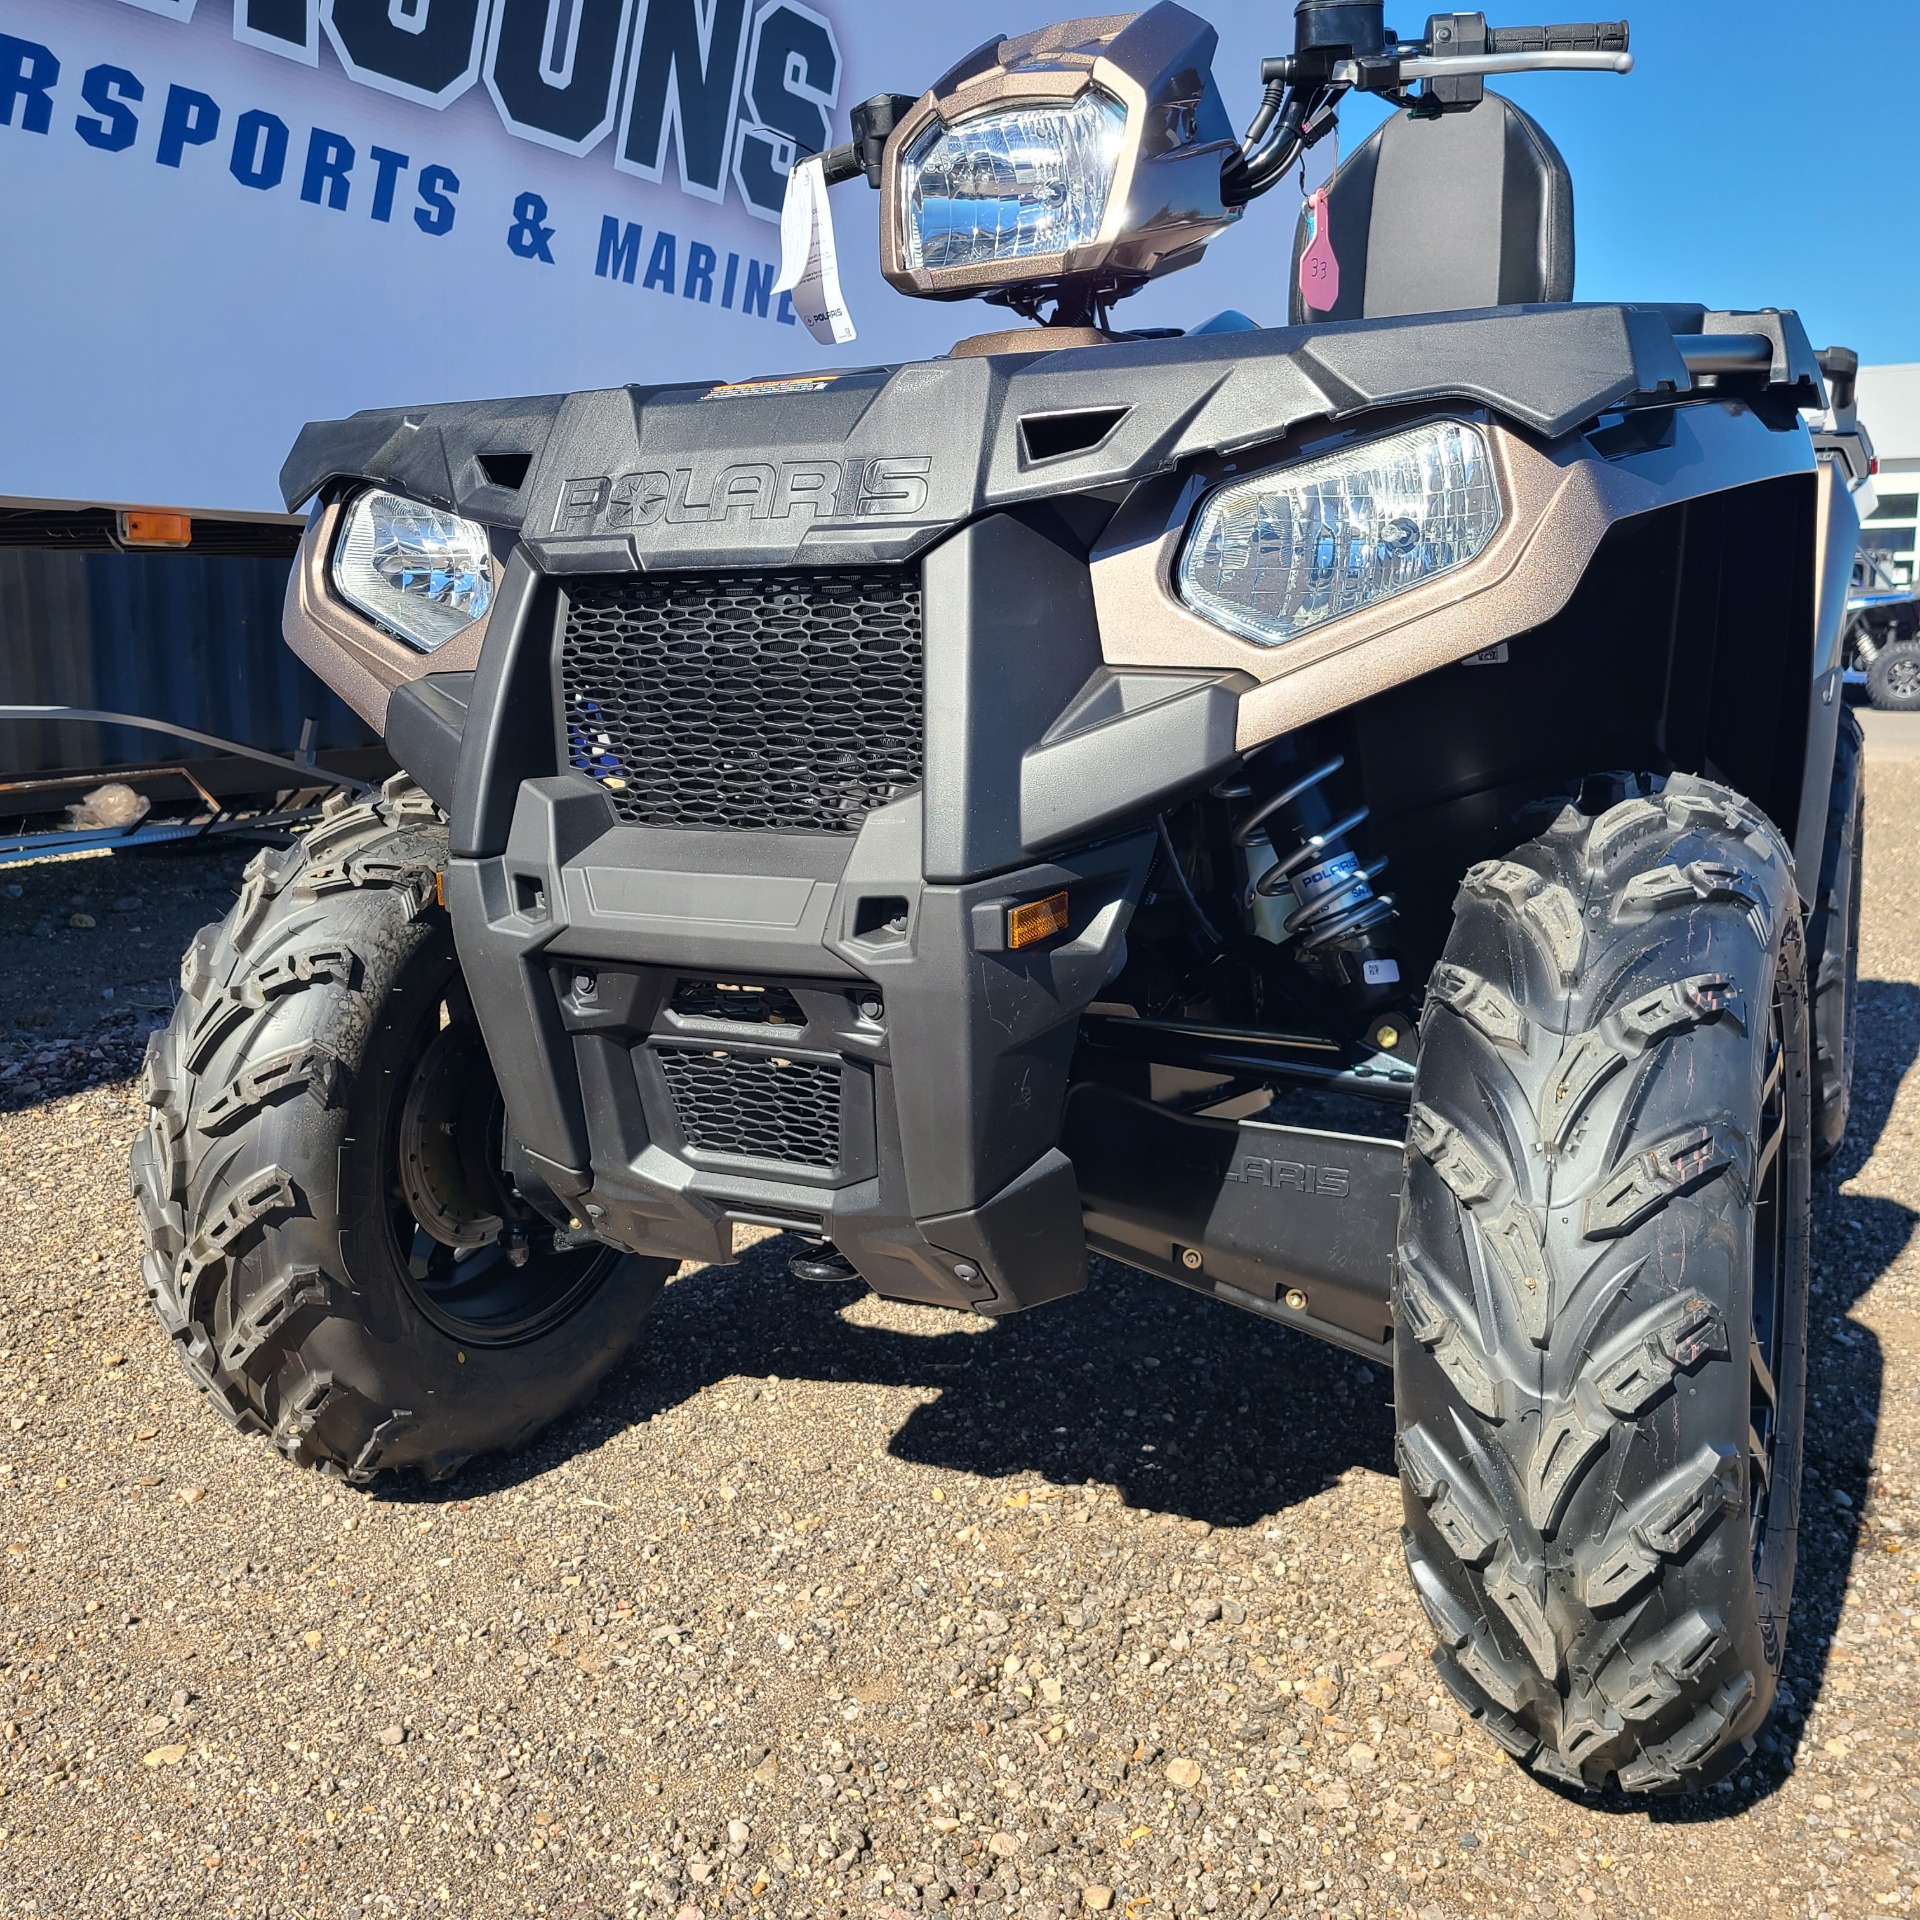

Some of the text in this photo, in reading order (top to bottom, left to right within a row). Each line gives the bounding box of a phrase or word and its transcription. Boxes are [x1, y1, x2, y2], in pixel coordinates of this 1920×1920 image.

[507, 191, 556, 265] &
[1310, 257, 1328, 280] 33
[813, 308, 843, 323] POLARIS
[550, 456, 933, 533] POLARIS
[1302, 856, 1358, 888] POLARIS
